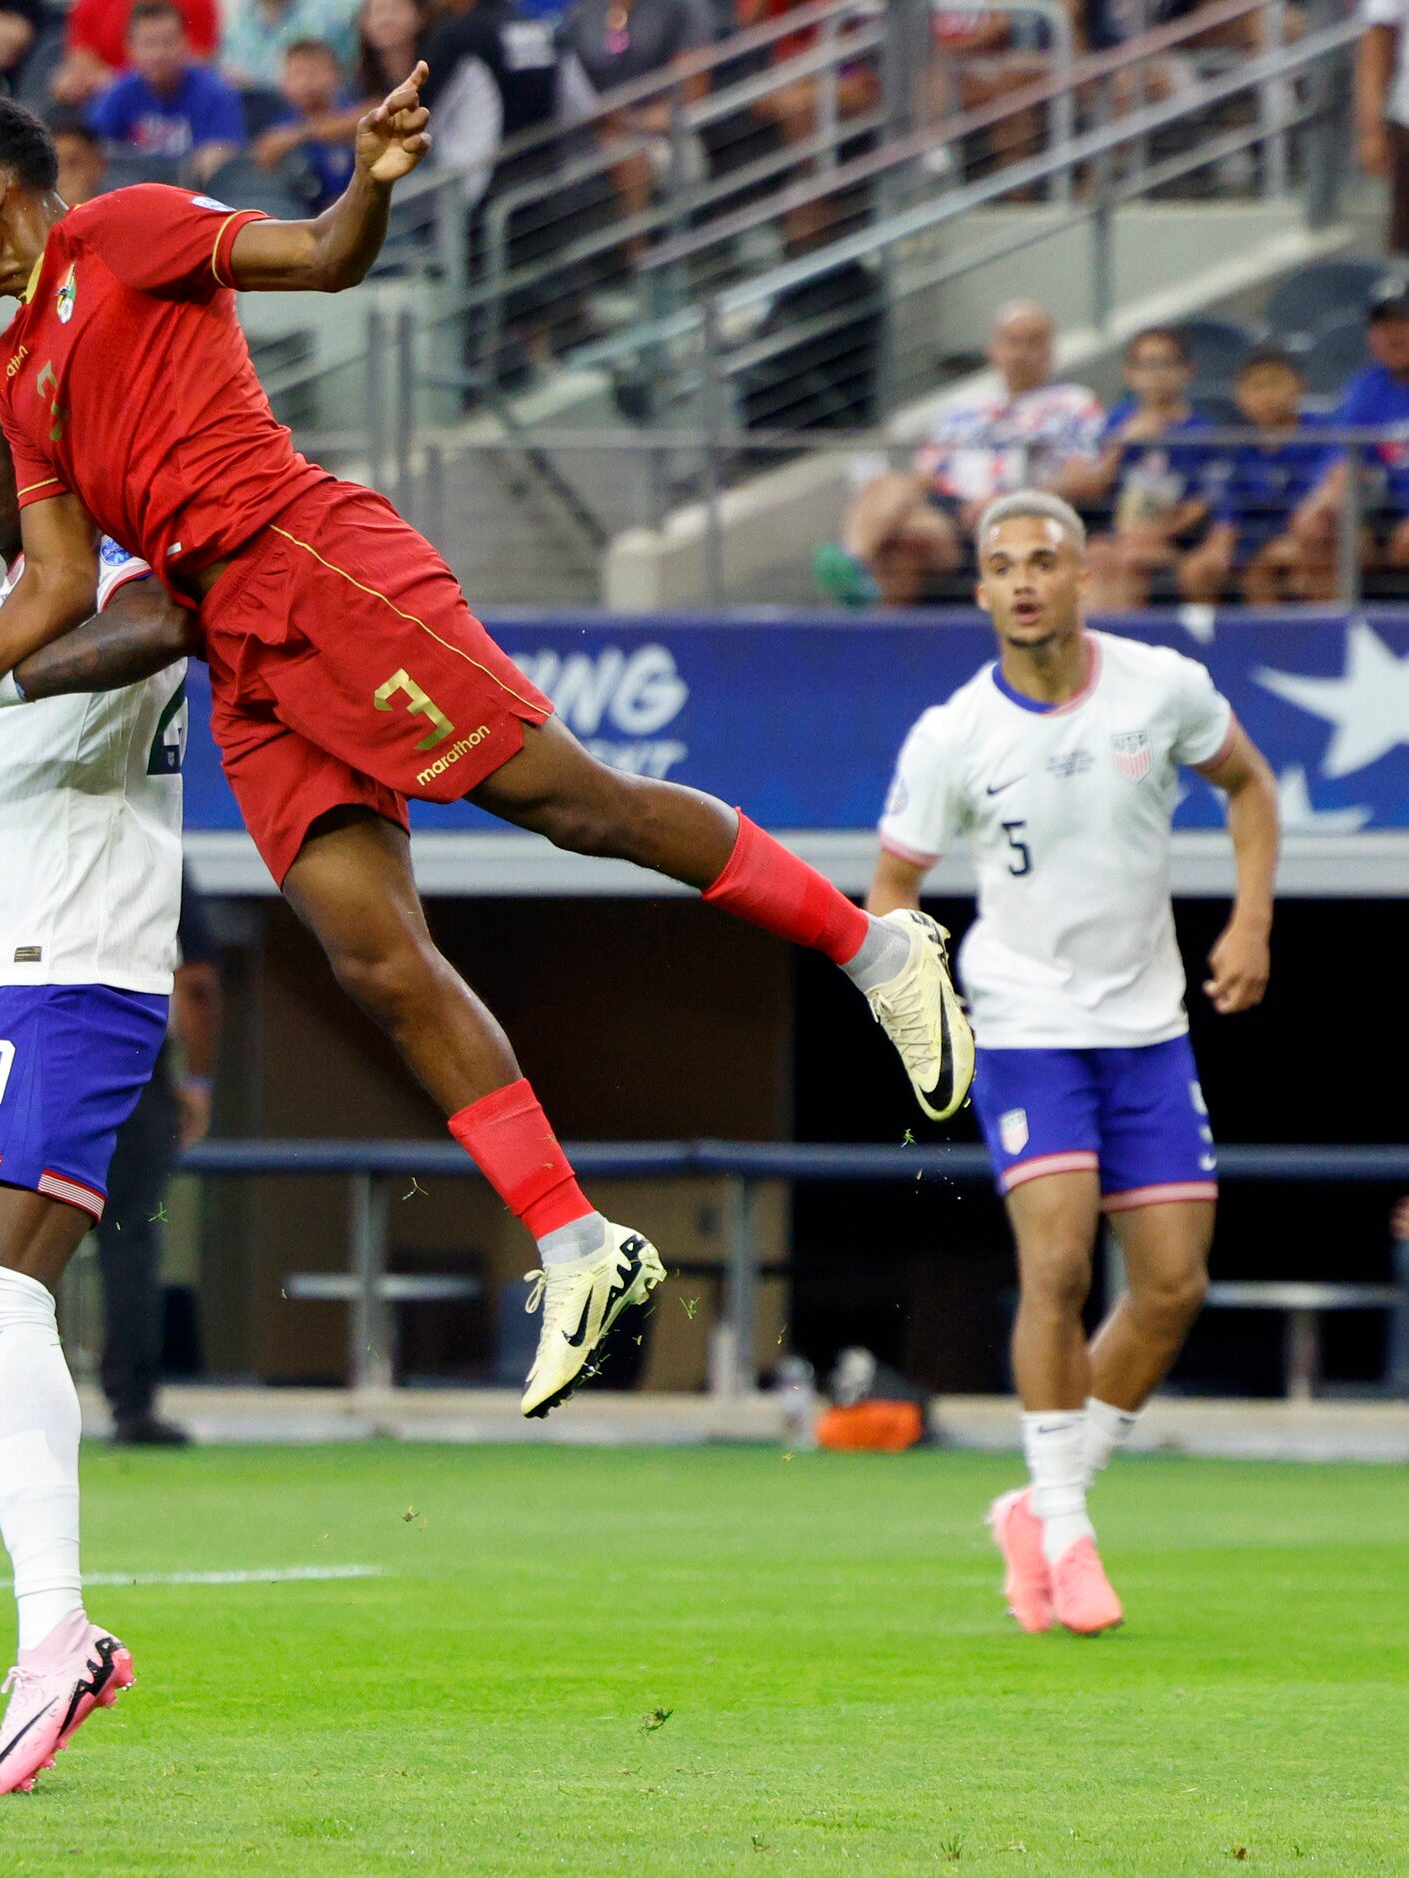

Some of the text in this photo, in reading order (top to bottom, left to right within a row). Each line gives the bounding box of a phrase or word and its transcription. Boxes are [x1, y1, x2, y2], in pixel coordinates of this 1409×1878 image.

[374, 667, 456, 750] 3
[416, 724, 491, 786] marathon
[1000, 819, 1034, 877] 5
